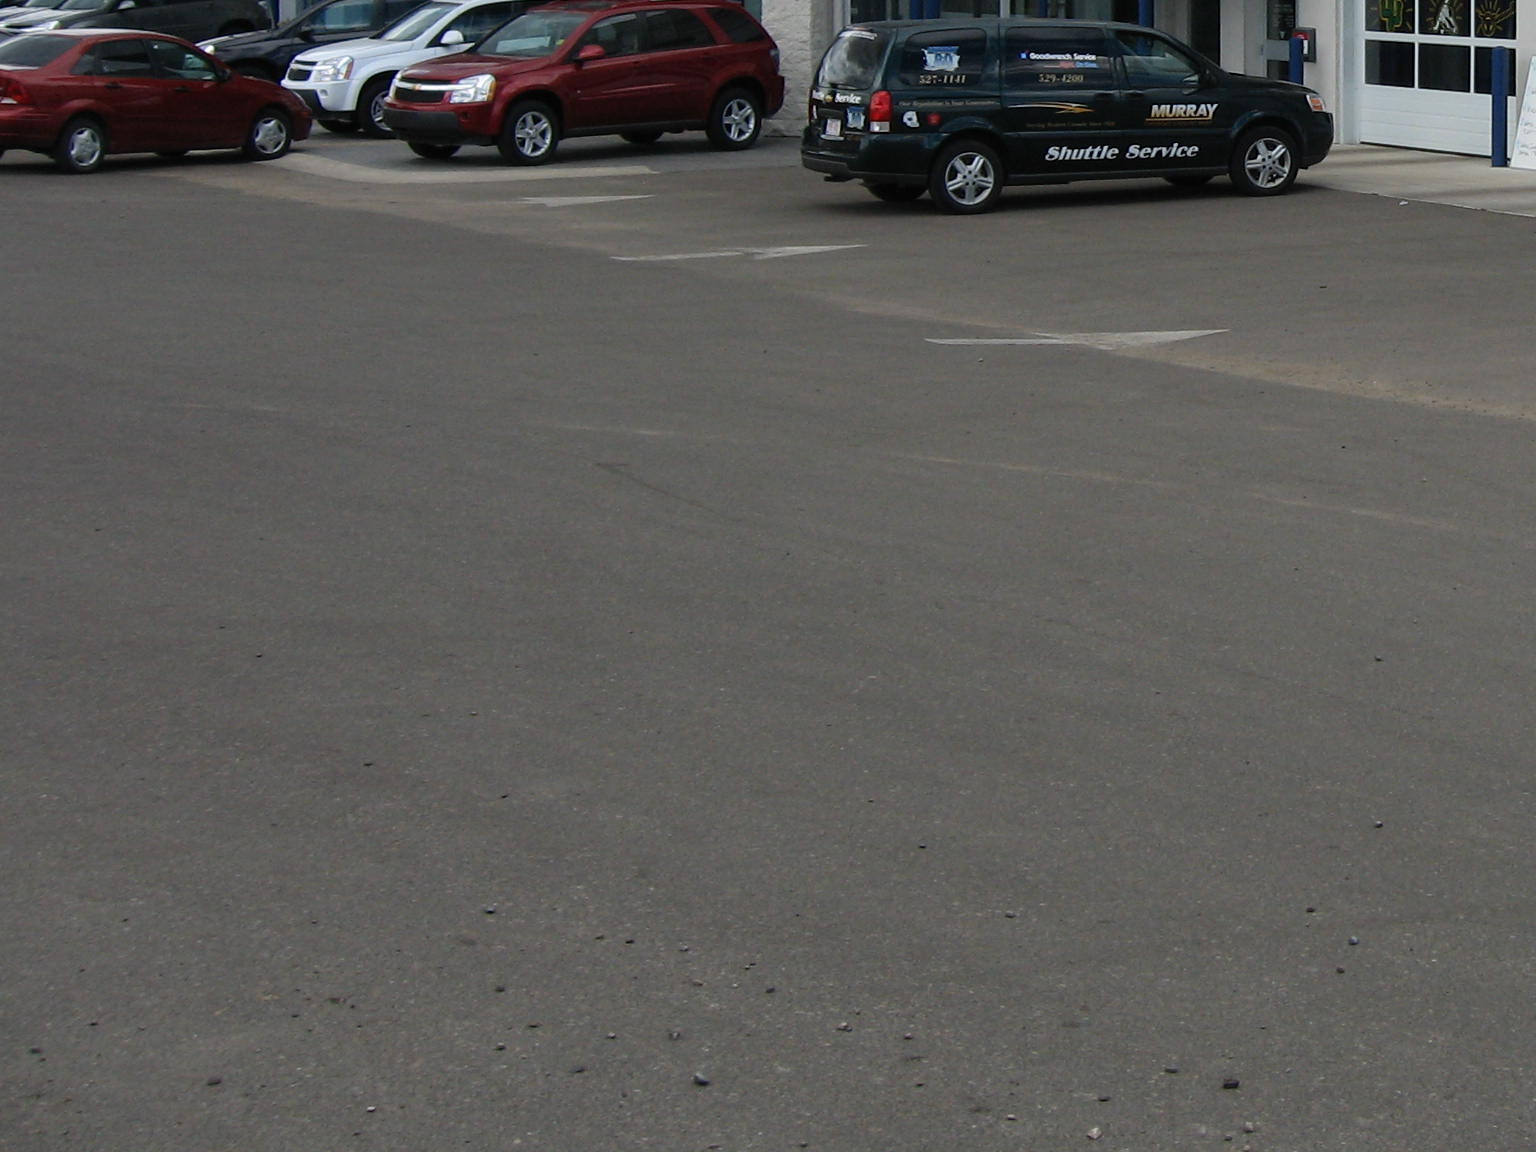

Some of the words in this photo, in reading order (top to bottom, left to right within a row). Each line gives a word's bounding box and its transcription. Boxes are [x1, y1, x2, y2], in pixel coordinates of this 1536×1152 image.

[1073, 53, 1097, 61] Service
[834, 92, 862, 104] Service
[1151, 104, 1218, 118] MURRAY
[1045, 145, 1119, 161] Shuttle
[1125, 142, 1199, 159] Service
